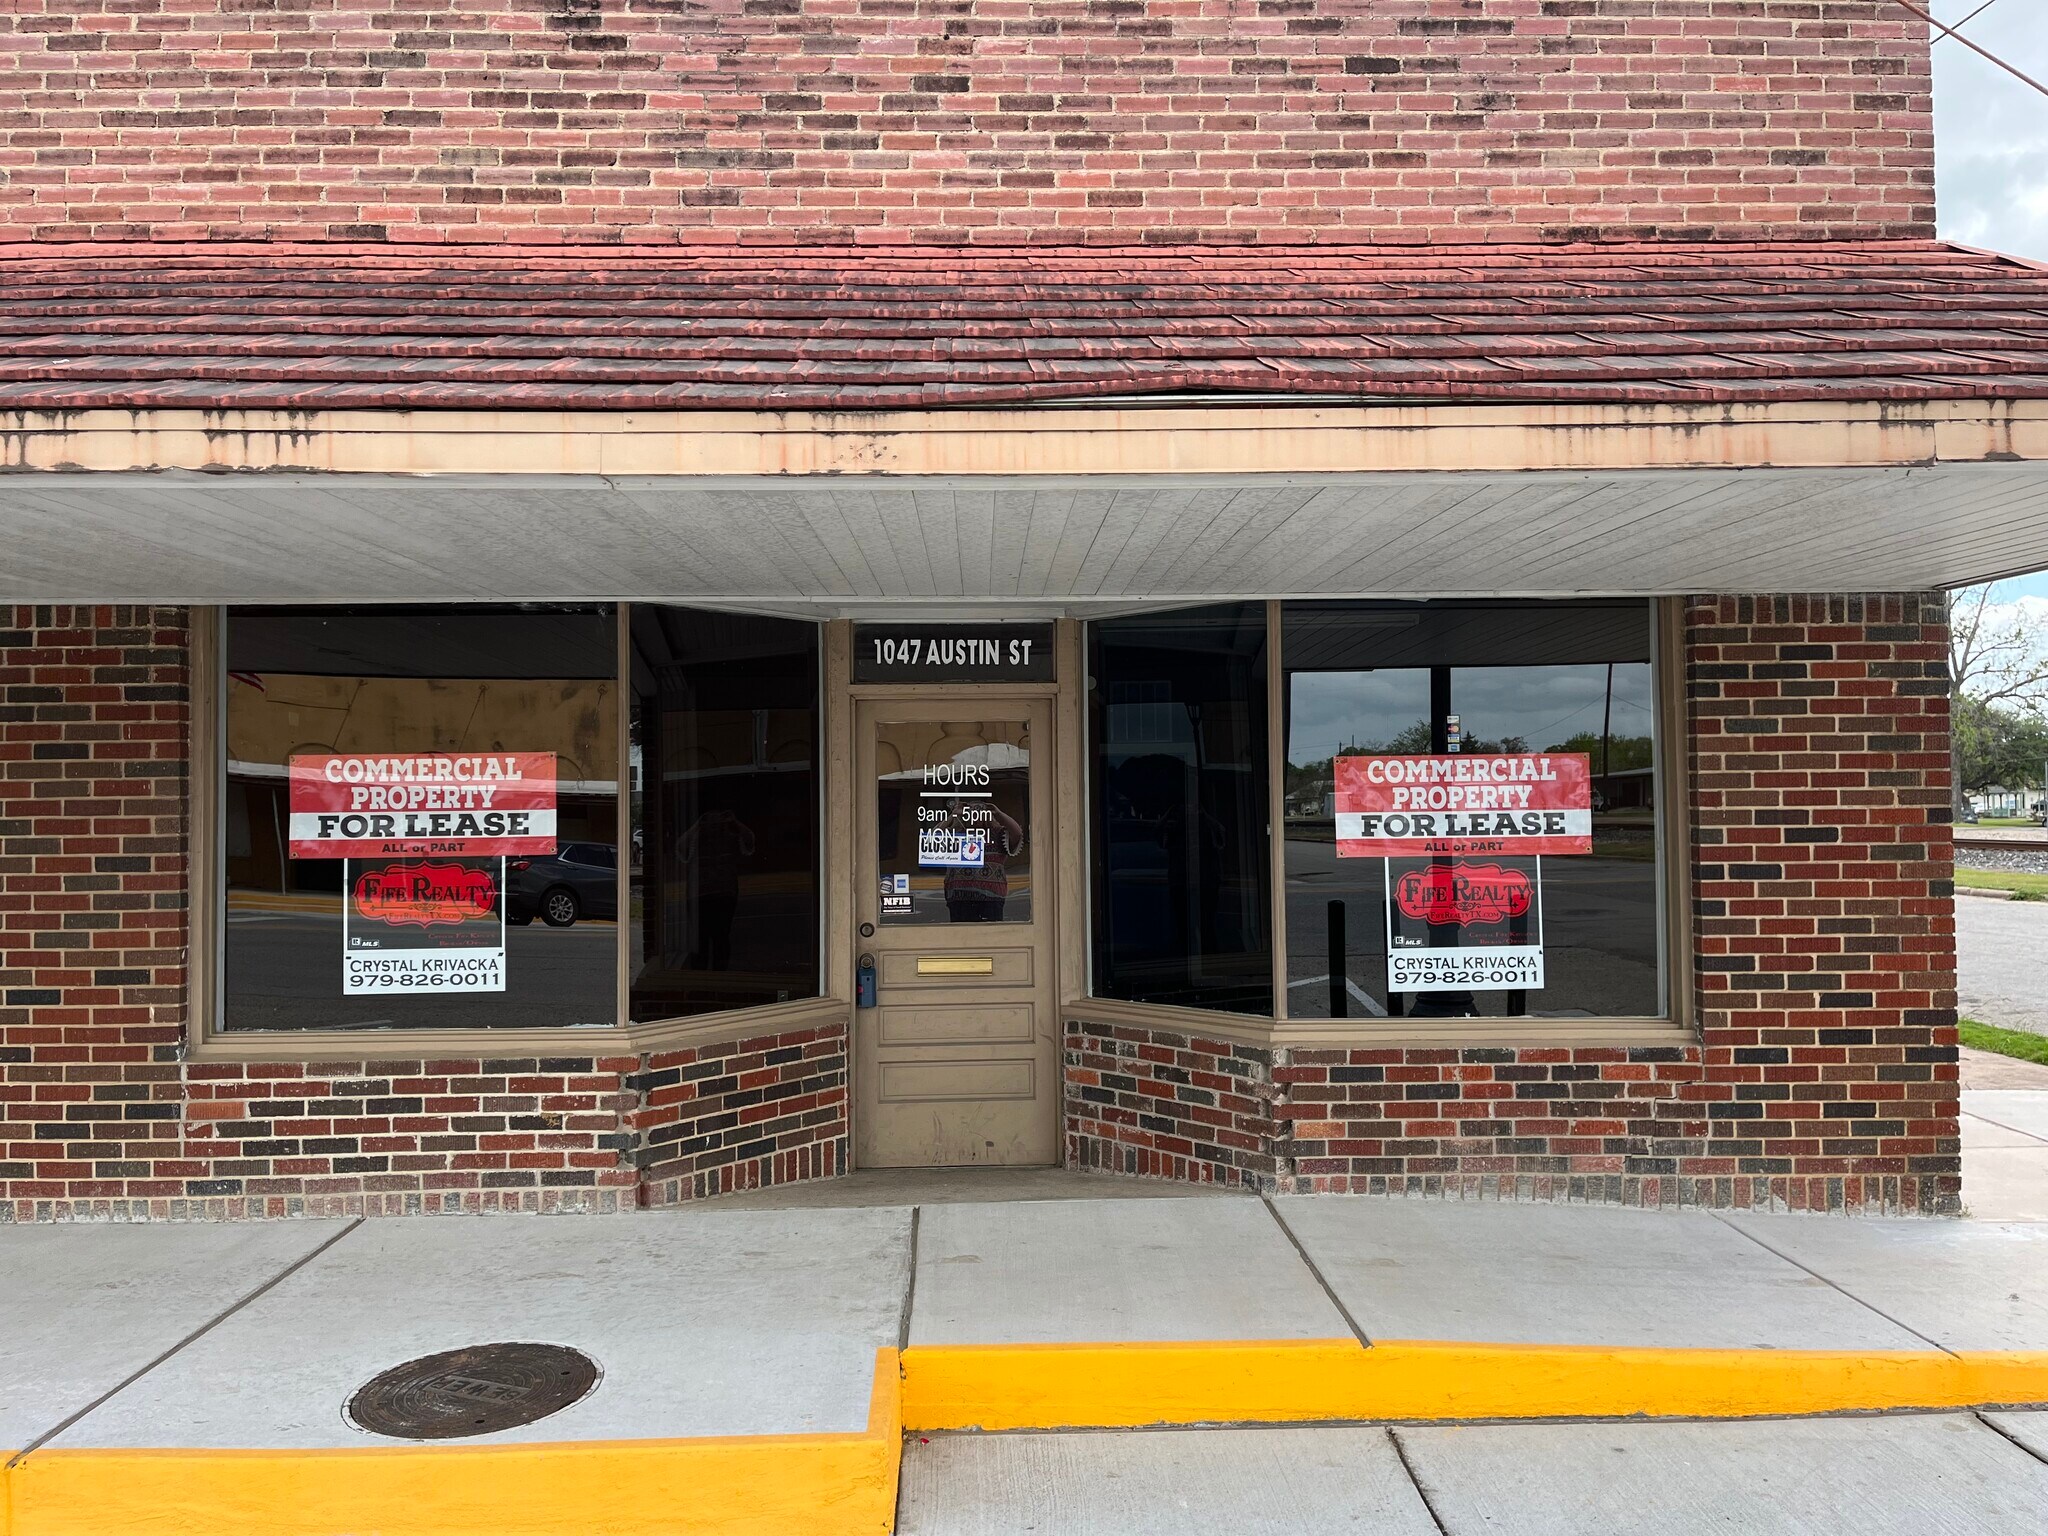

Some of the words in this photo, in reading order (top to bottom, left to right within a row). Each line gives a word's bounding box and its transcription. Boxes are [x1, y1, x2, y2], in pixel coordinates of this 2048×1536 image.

[874, 638, 921, 665] 1047
[926, 639, 1000, 666] AUSTIN
[1009, 639, 1032, 666] ST
[324, 757, 522, 784] COMMERCIAL
[923, 764, 990, 786] HOURS
[1367, 758, 1557, 784] COMMERCIAL
[351, 784, 497, 810] PROPERTY
[1392, 784, 1533, 810] PROPERTY
[317, 814, 396, 838] FOR
[404, 812, 530, 837] LEASE
[917, 806, 948, 822] 9am
[962, 806, 992, 826] 5pm
[1361, 814, 1437, 838] FOR
[1445, 812, 1566, 836] LEASE
[382, 843, 408, 853] ALL
[412, 844, 428, 852] or
[430, 842, 465, 852] PART
[921, 837, 960, 853] CLOSED
[1424, 842, 1450, 852] ALL
[1470, 842, 1504, 852] PART
[883, 896, 911, 906] NFIB
[350, 960, 418, 973] CRYSTAL
[422, 958, 499, 972] KRIVACKA
[1394, 957, 1459, 970] CRYSTAL
[1463, 956, 1537, 969] KRIVACKA
[350, 972, 500, 987] 979-826-0011
[1394, 970, 1538, 984] 979-826-0011
